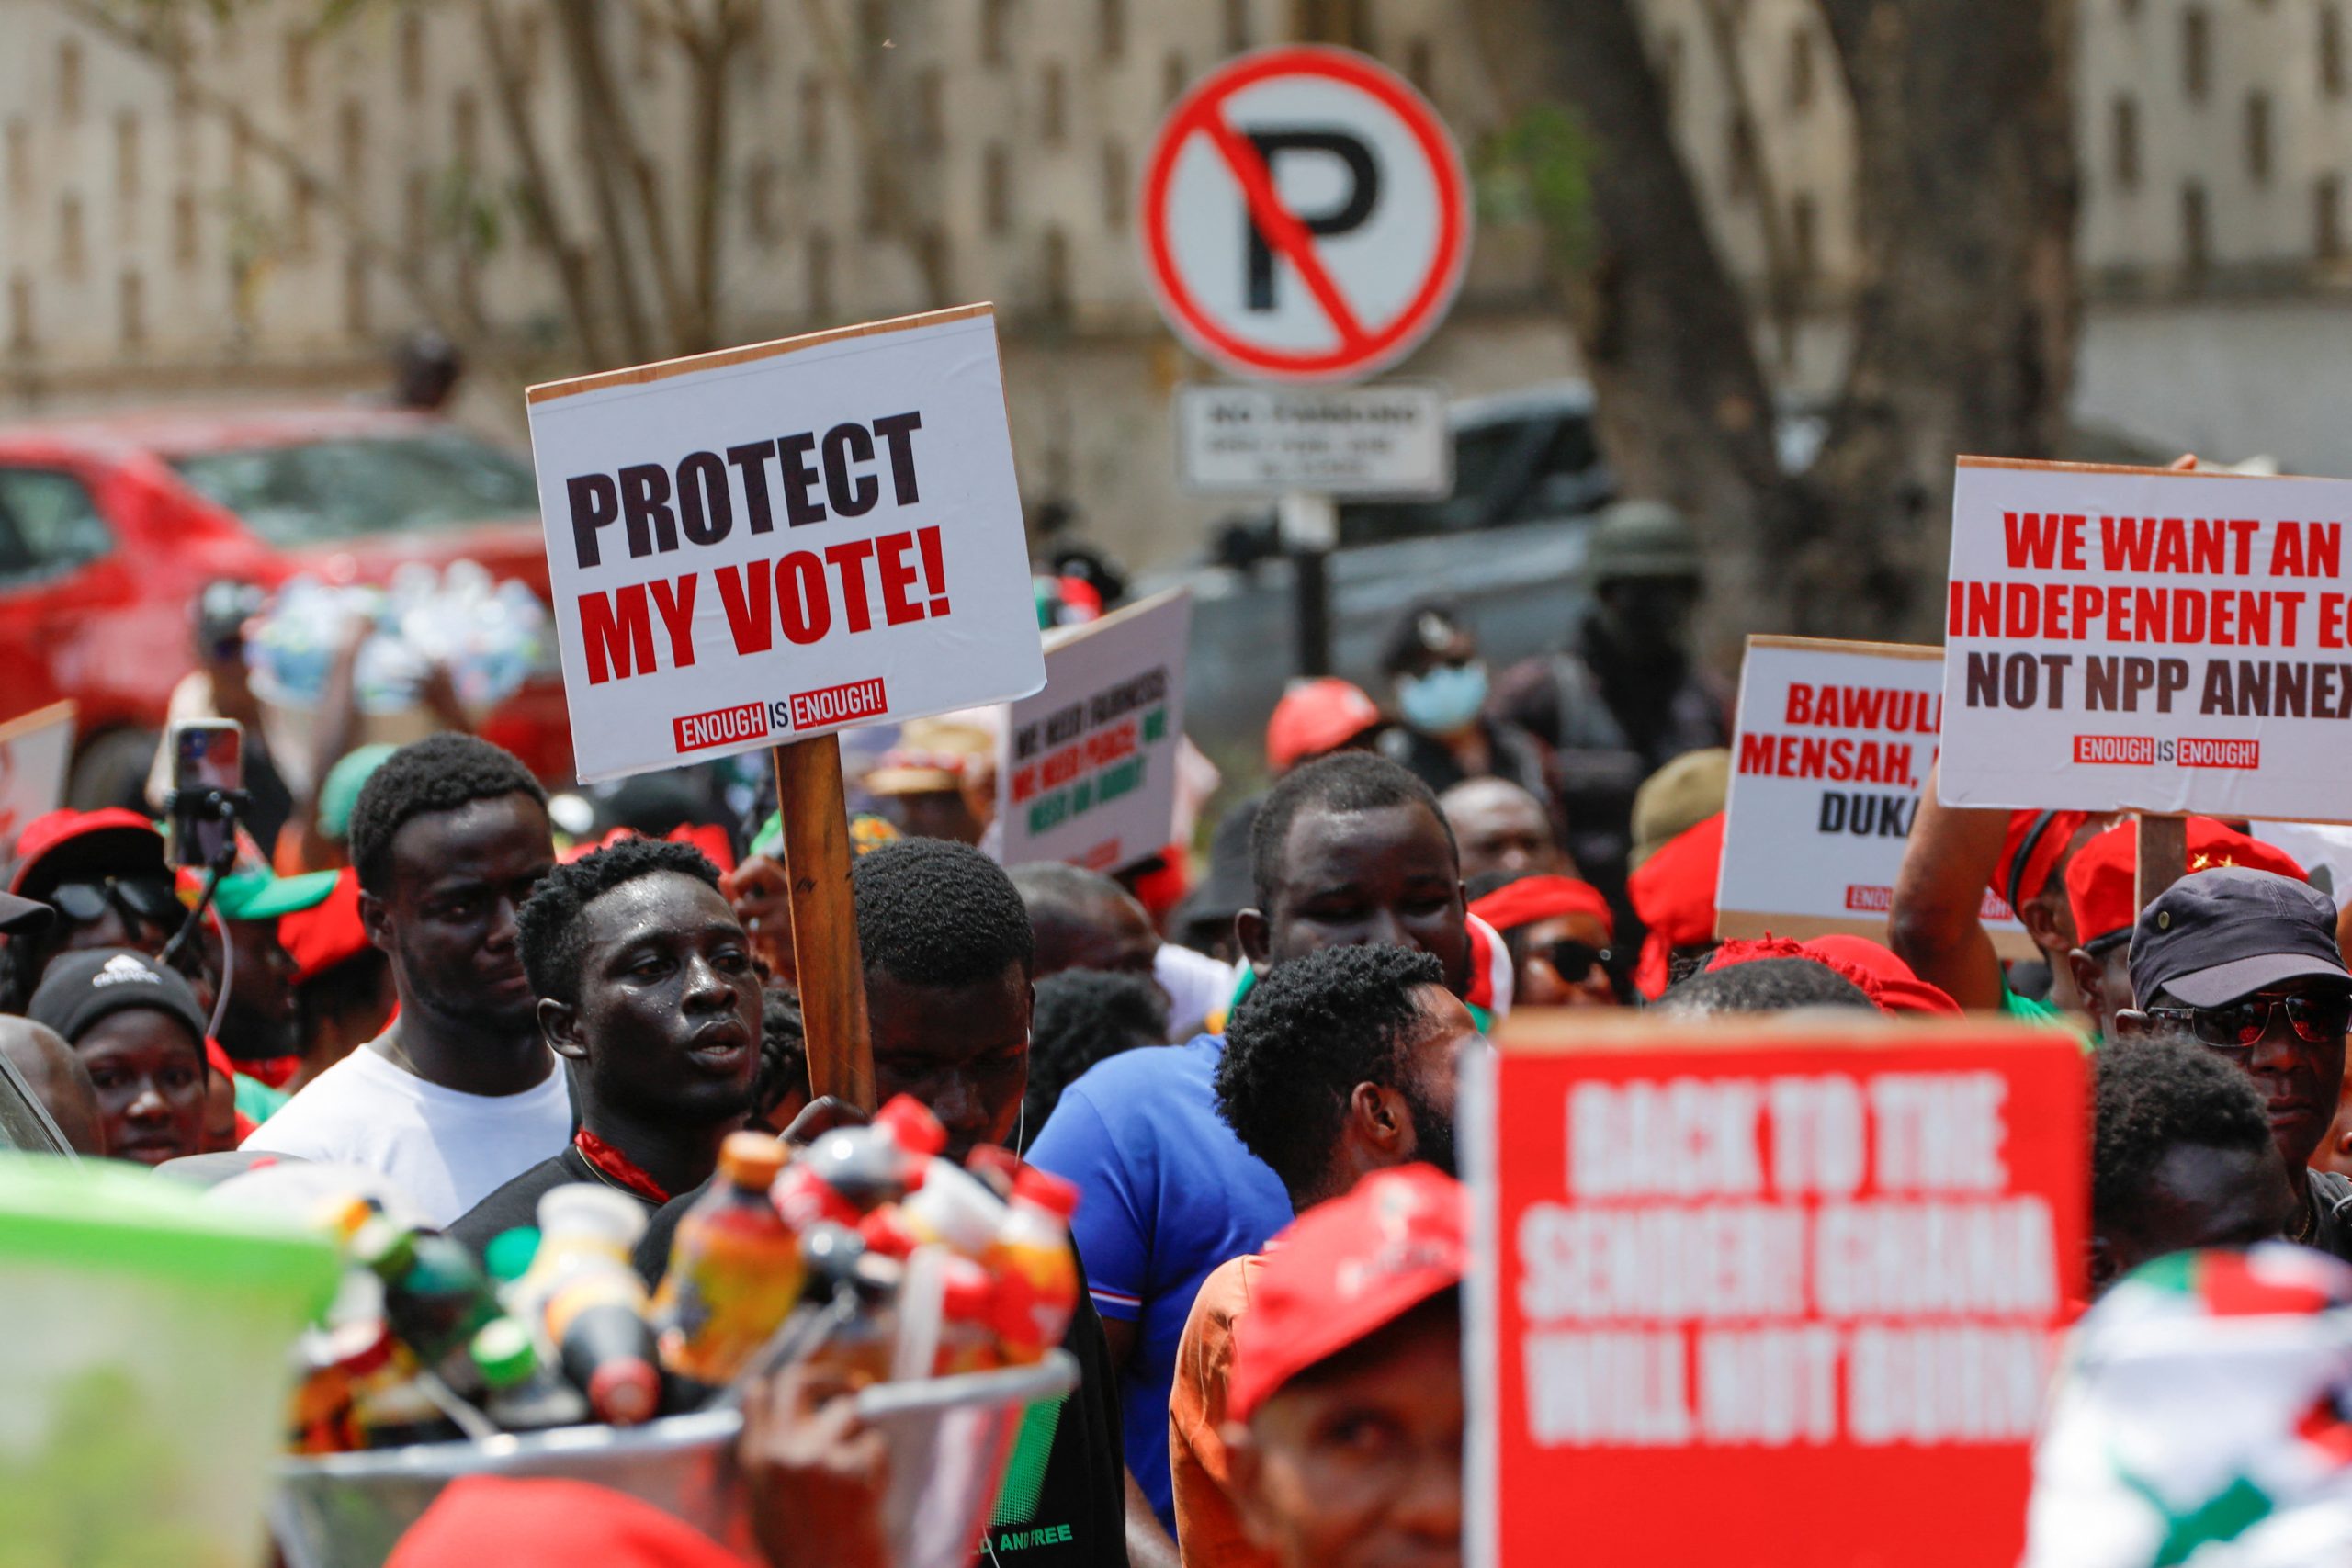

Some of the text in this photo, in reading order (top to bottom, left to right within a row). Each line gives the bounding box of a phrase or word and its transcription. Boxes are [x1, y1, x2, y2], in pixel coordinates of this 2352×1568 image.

[566, 410, 922, 569] PROTECT
[2002, 511, 2342, 578] WE WANT AN
[577, 525, 951, 686] MY VOTE!
[1948, 581, 2352, 649] INDEPENDENT E
[681, 682, 883, 748] ENOUGH IS ENOUGH!
[1784, 681, 1942, 735] BAWUL
[1965, 651, 2073, 711] NOT
[2084, 654, 2190, 715] NPP
[1738, 732, 1919, 790] MENSAH,
[2079, 737, 2257, 766] ENOUGH IS ENOUGH!
[1570, 1076, 2004, 1197] BACK TO THE
[1527, 1328, 1690, 1442] WILL
[1700, 1325, 1836, 1441] NOT
